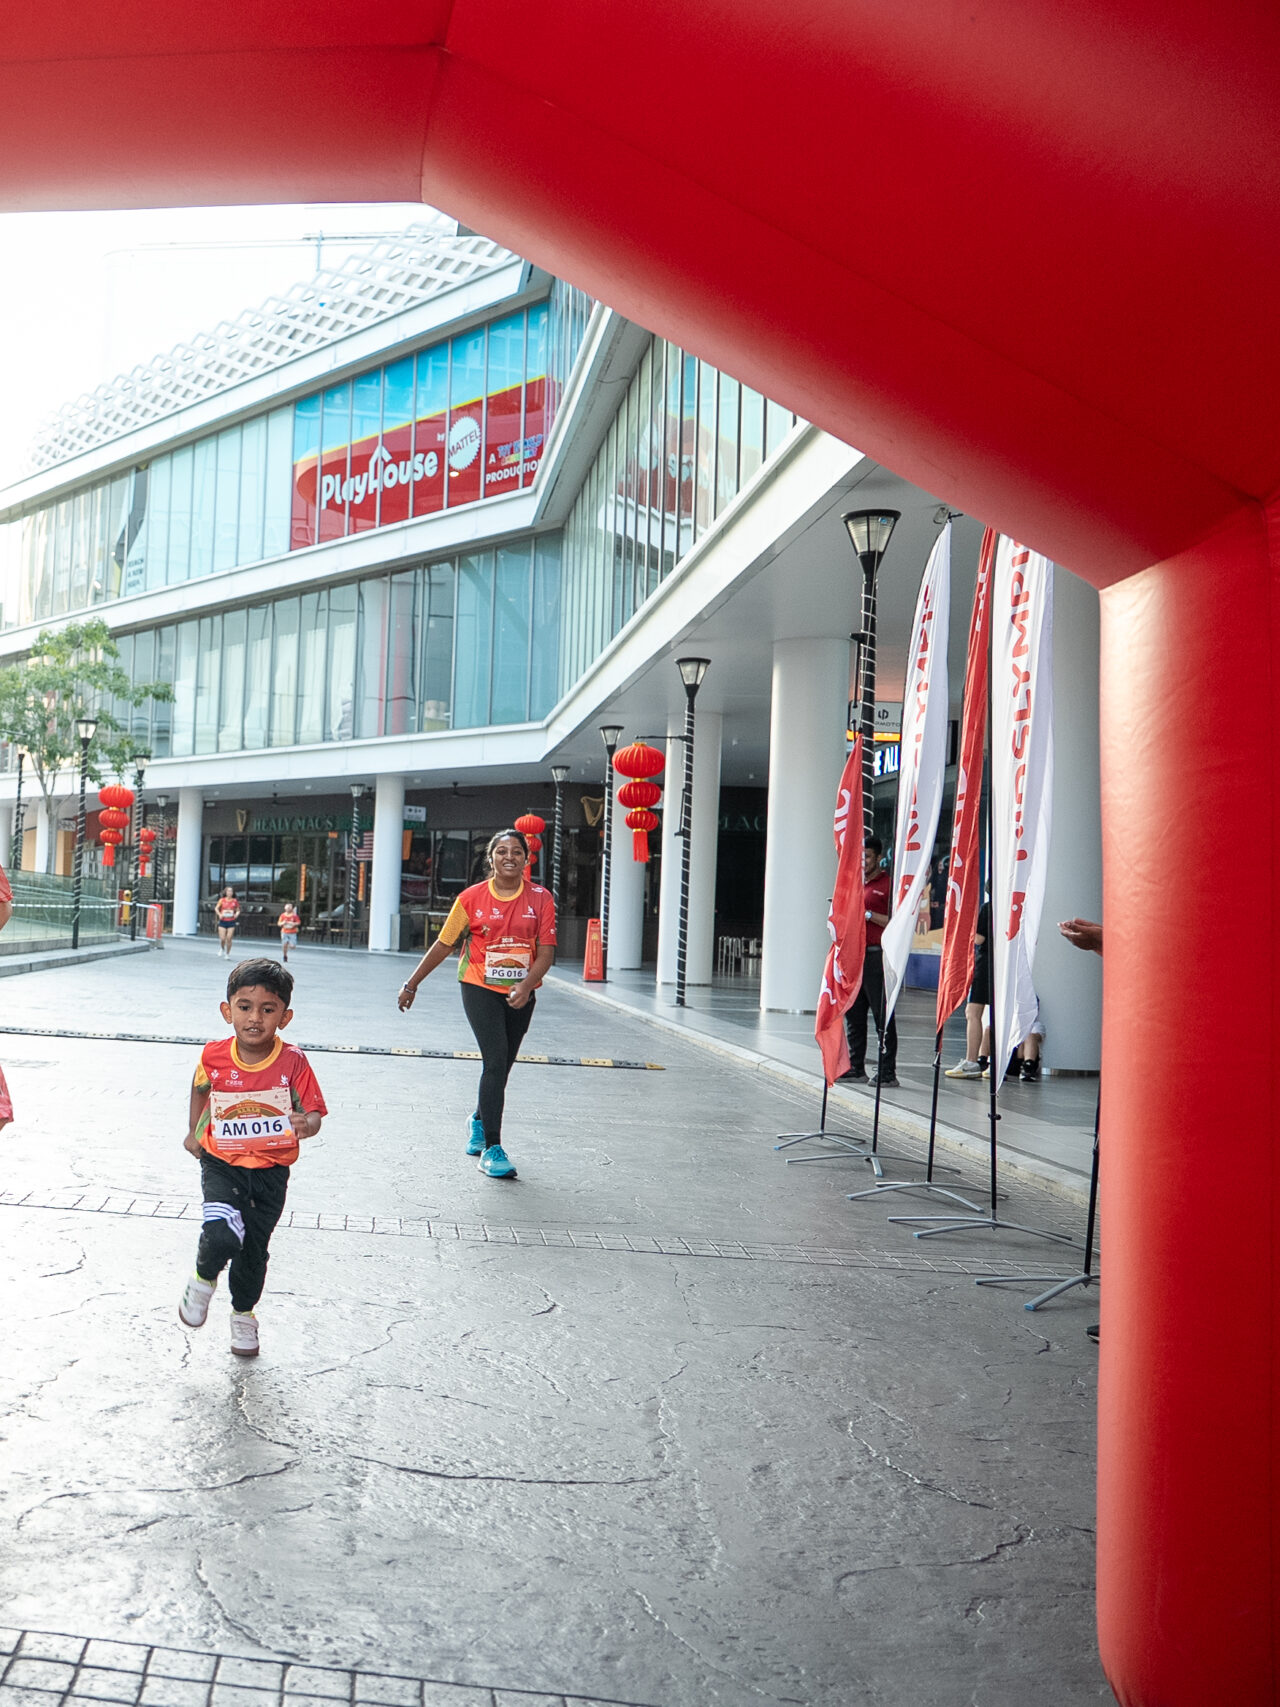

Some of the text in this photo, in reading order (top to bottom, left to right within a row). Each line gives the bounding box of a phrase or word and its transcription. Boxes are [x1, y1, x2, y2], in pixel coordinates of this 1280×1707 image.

[448, 429, 481, 458] MATTEL
[489, 453, 497, 465] A
[492, 969, 523, 978] PG 016
[222, 1119, 283, 1136] AM 016
